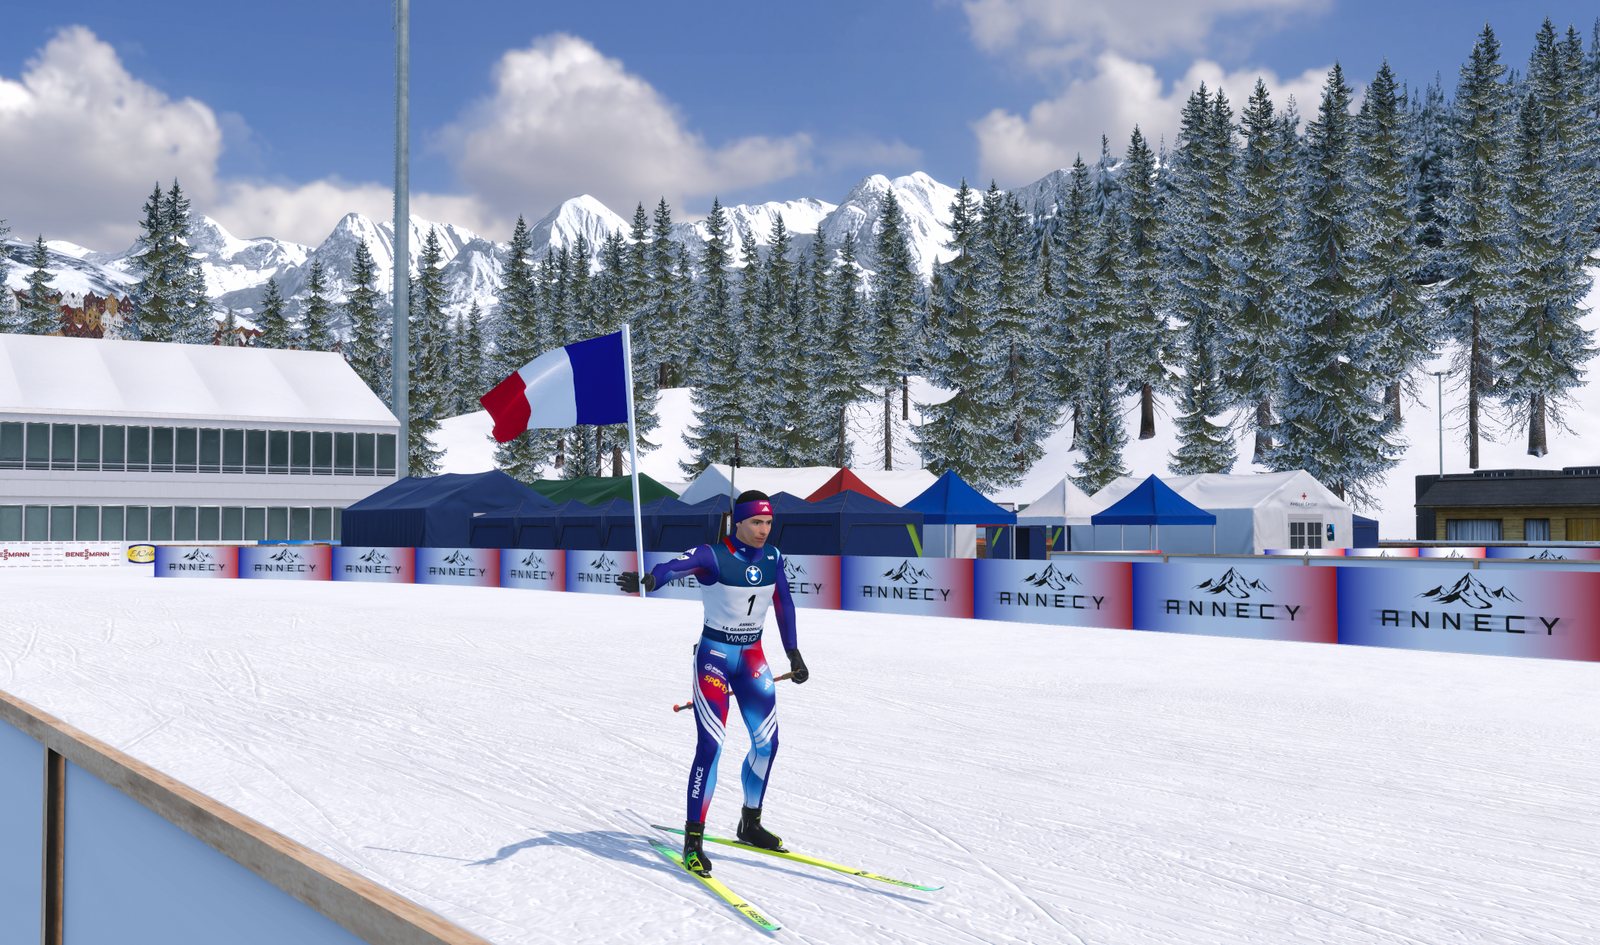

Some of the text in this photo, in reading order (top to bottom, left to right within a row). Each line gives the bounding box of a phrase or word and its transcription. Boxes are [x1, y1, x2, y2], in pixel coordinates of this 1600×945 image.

[169, 563, 225, 572] ANNECY
[254, 563, 316, 573] ANNECY
[345, 564, 401, 575] ANNECY
[429, 566, 486, 577] ANNECY
[510, 569, 555, 580] ANNECY
[578, 572, 620, 584] ANNEC
[863, 586, 950, 602] ANNECY
[1000, 591, 1105, 610] ANNECY
[747, 594, 757, 616] 1
[1166, 599, 1301, 622] ANNECY
[1381, 609, 1560, 636] ANNECY
[691, 766, 704, 799] FRANCE
